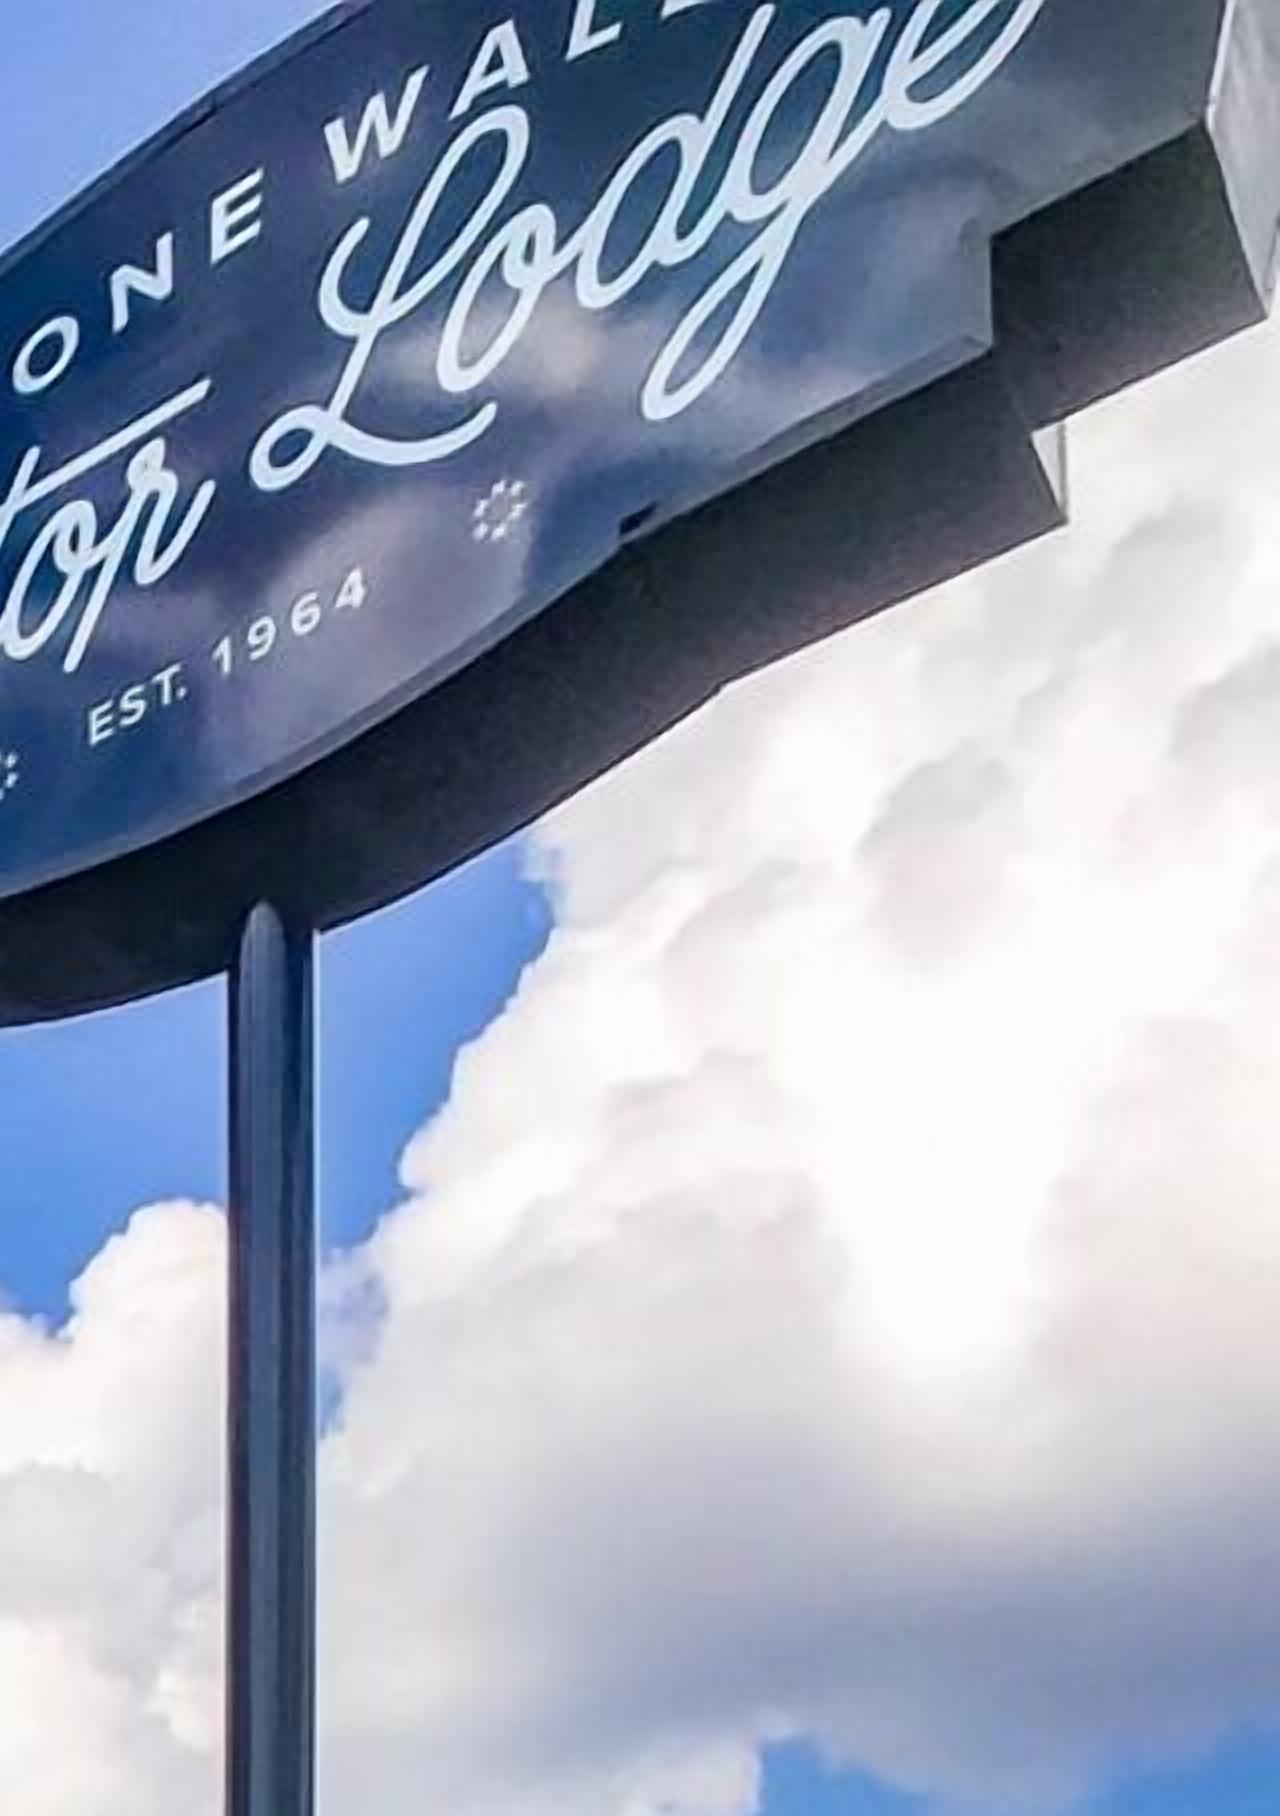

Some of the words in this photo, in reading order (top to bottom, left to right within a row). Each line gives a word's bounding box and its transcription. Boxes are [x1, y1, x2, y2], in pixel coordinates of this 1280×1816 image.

[322, 0, 714, 184] WAL
[88, 658, 190, 746] EST.
[211, 564, 369, 676] 1964
